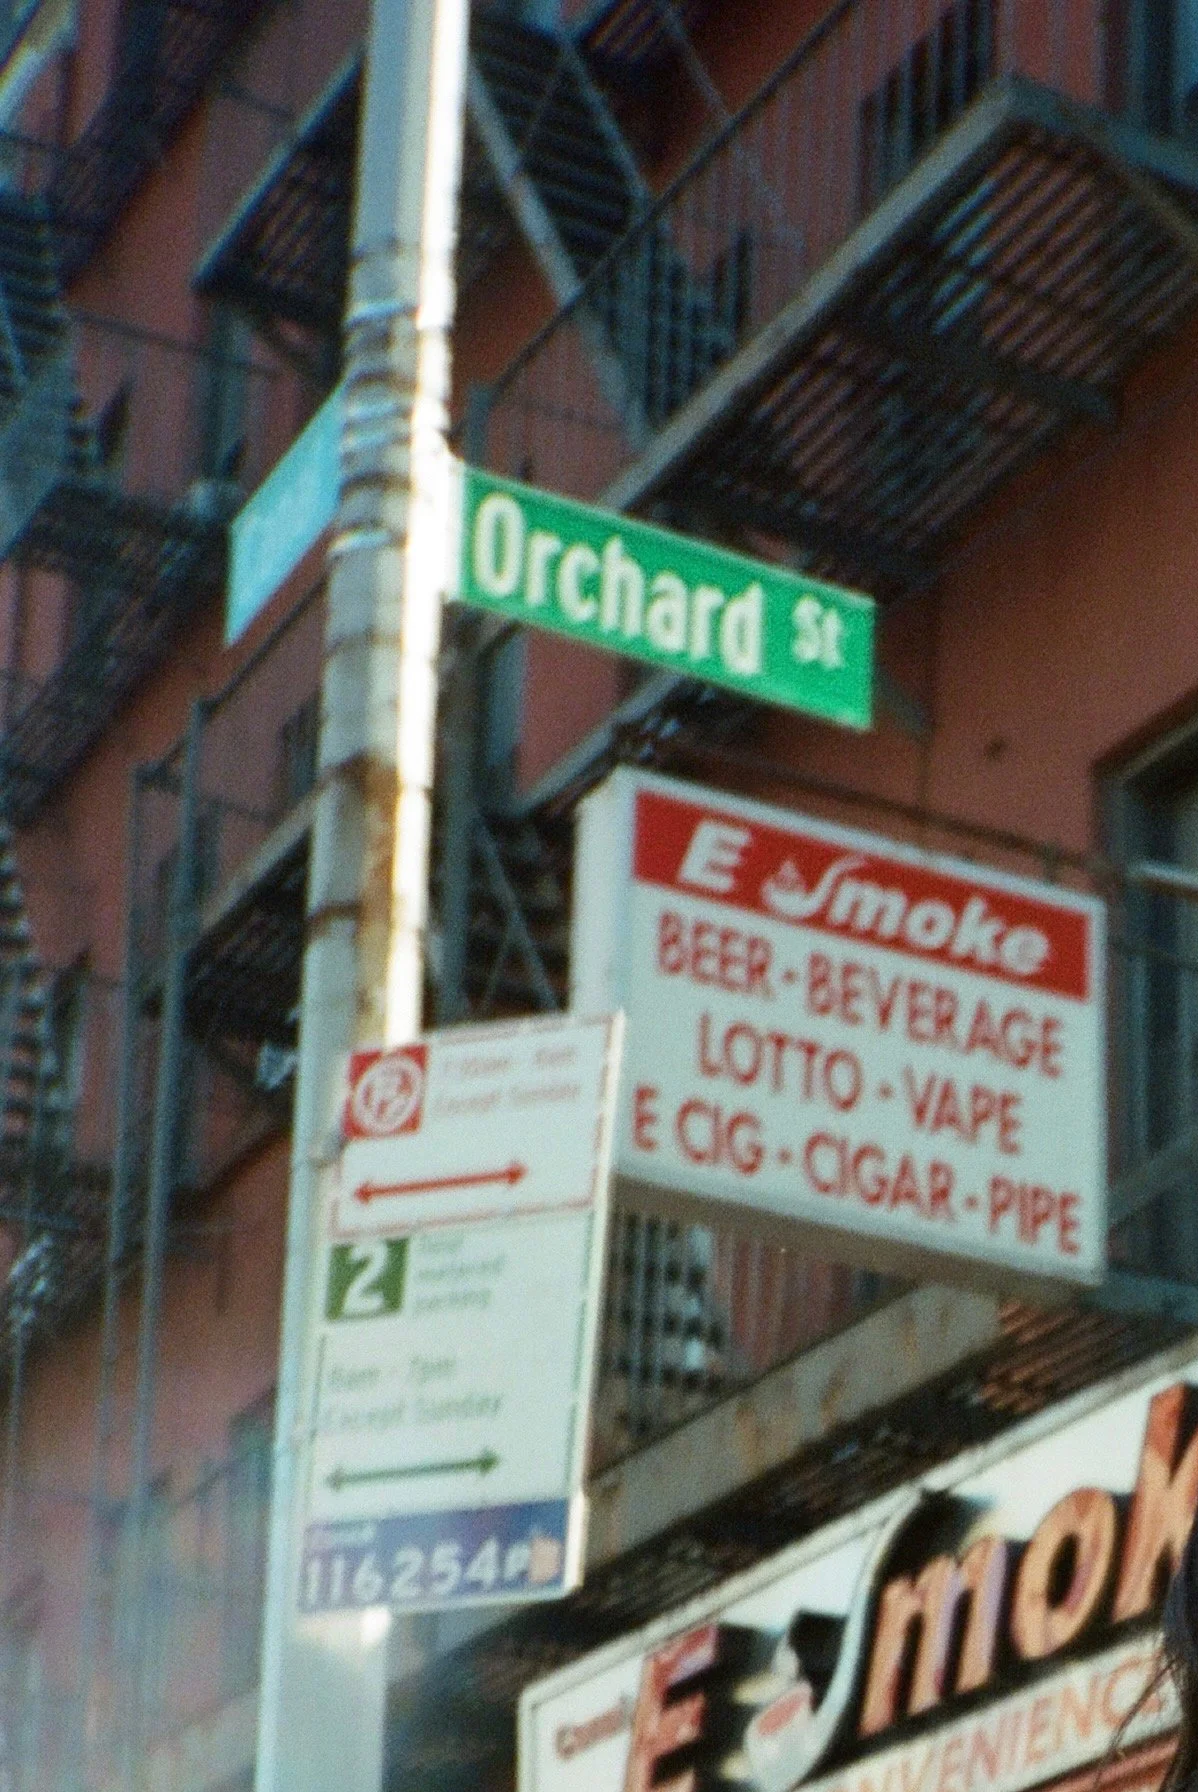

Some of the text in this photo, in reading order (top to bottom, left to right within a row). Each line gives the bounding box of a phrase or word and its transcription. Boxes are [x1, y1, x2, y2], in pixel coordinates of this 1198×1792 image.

[472, 491, 763, 677] Orchard
[791, 594, 844, 669] St
[676, 819, 1051, 976] E Smoke
[656, 908, 1064, 1080] BEER BEVERAGE
[698, 1009, 1024, 1156] LOTTO VAPE
[631, 1082, 1081, 1256] E CIG CIGAR PIPE
